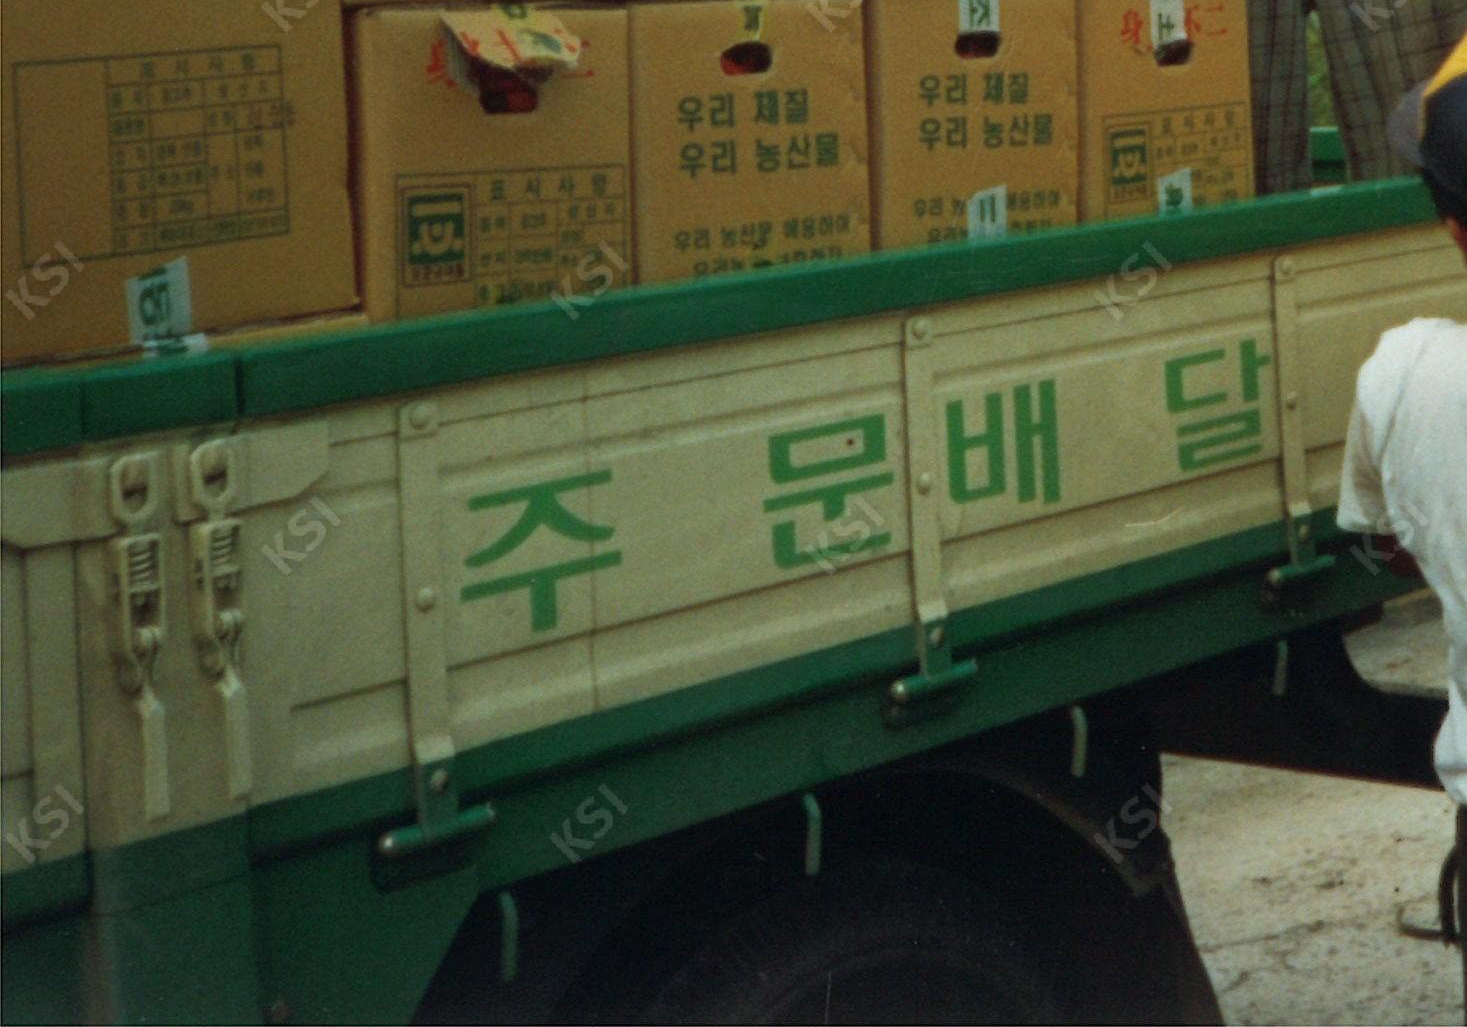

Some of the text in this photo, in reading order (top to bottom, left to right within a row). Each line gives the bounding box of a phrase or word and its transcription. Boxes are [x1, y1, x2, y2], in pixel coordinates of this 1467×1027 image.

[918, 74, 968, 106] 우리
[676, 92, 737, 132] 우리
[918, 113, 1054, 153] 우리 농산물
[678, 132, 841, 178] 우리 농산물
